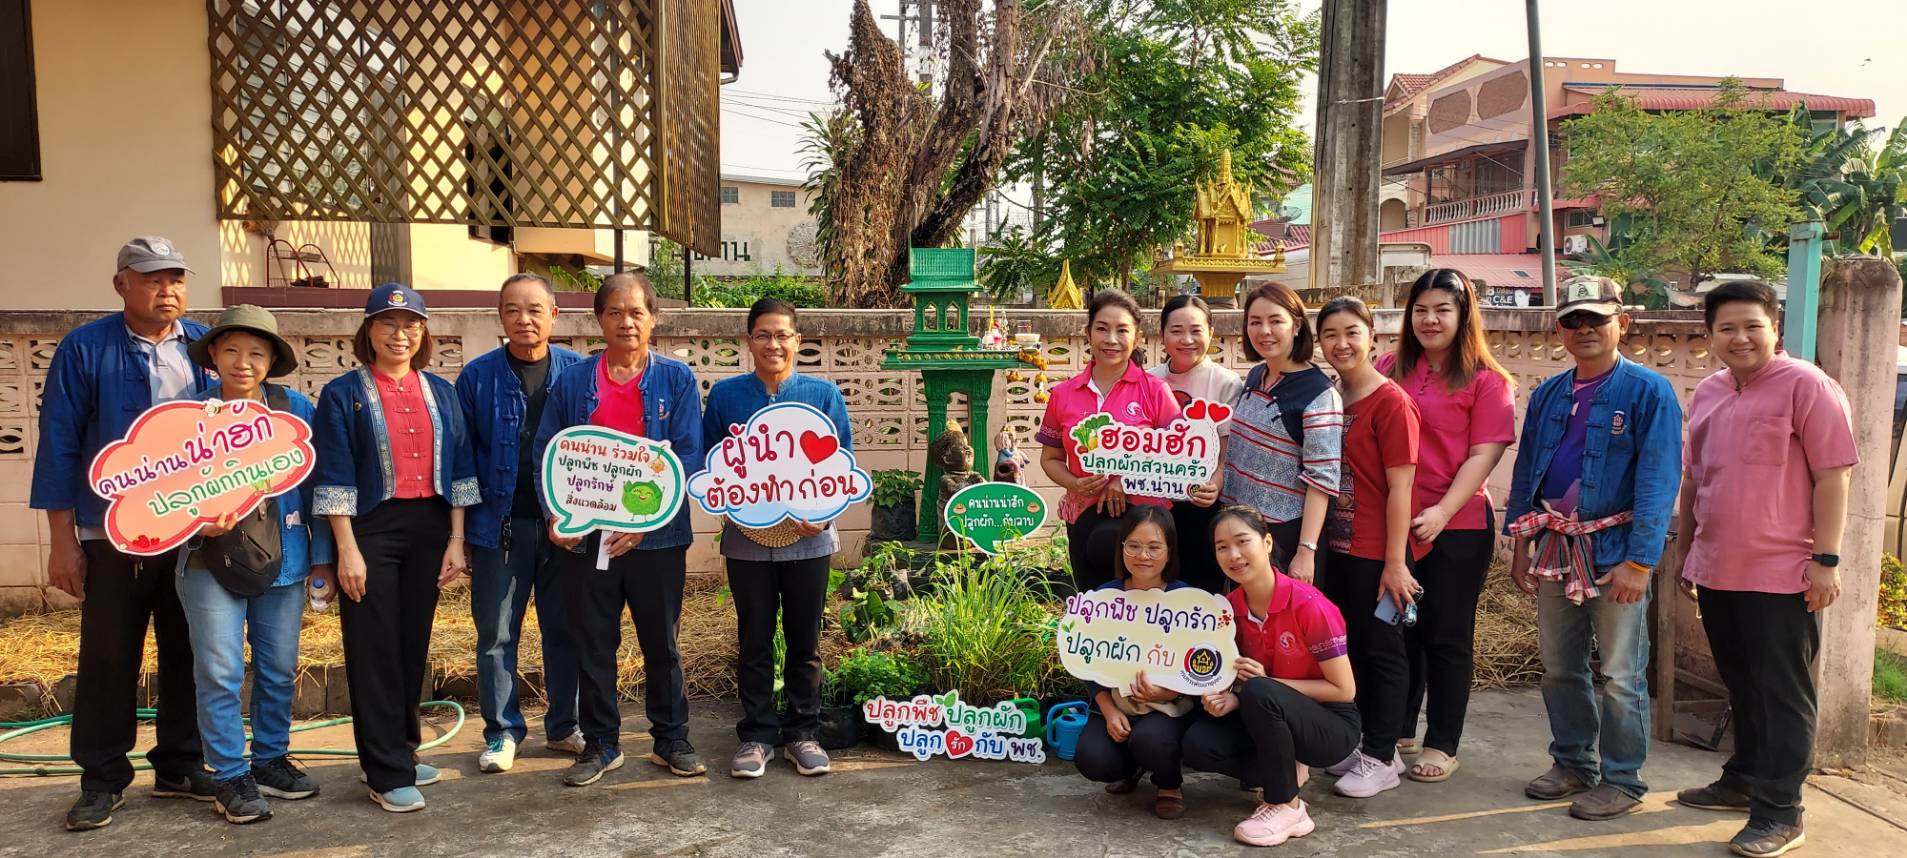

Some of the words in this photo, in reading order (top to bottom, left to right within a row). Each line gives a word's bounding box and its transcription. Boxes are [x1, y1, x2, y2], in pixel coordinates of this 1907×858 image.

[560, 439, 607, 457] คนน่าน
[612, 443, 650, 463] ร่วมใจ
[722, 424, 795, 479] ผู้นำ
[1101, 423, 1206, 458] ฮอมฮัก
[559, 454, 598, 472] ปลูกพืช
[603, 461, 642, 479] ปลูกผัก
[1082, 453, 1207, 477] ปลูกผักสวนครัว
[149, 449, 304, 516] ปลูกผักกินเอง
[567, 474, 614, 492] ปลูกรักษ์
[1068, 594, 1138, 624] ปลูกพืช
[1145, 603, 1216, 633] ปลูกรัก
[1066, 632, 1140, 664] ปลูกผัก
[1147, 644, 1176, 667] กับ
[866, 699, 941, 727] ปลูกพืช
[946, 704, 1023, 733] ปลูกผัก
[901, 730, 942, 756] ปลูก
[951, 737, 966, 750] รัก
[975, 732, 1003, 754] กับ
